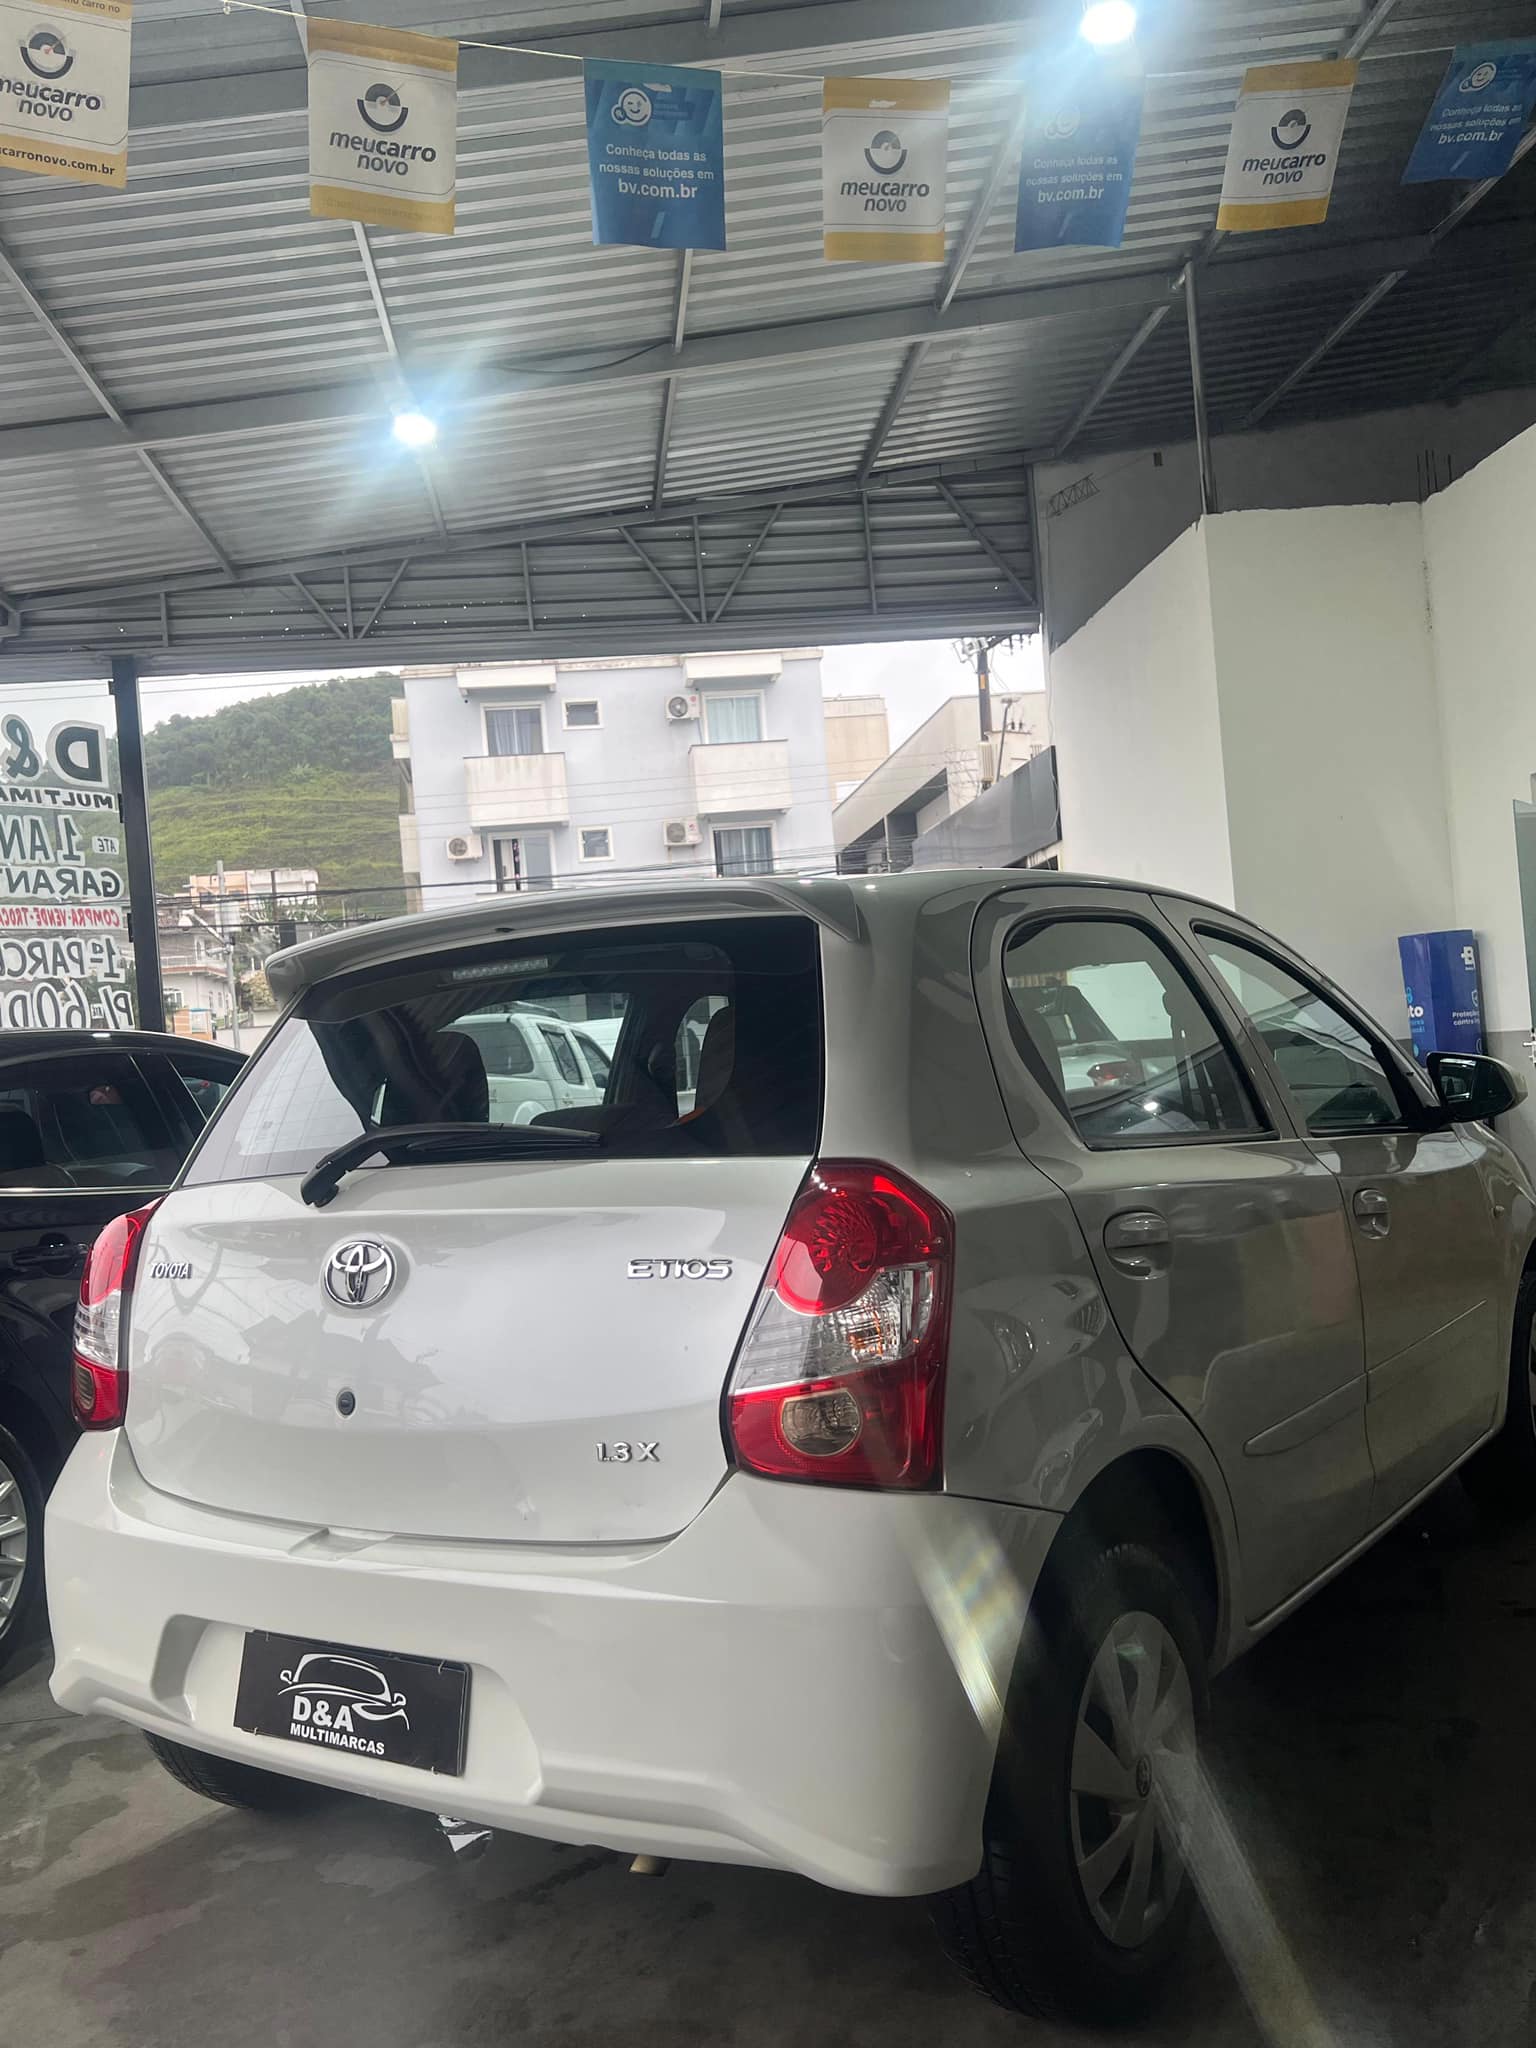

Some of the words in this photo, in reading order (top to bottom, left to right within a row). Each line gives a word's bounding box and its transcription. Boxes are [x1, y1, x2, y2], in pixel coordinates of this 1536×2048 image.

[19, 99, 73, 122] novo
[329, 131, 437, 162] meucarro
[1438, 130, 1505, 145] bv.com.br
[0, 146, 115, 175] carronovo.com.br
[606, 143, 656, 161] Conheça
[658, 148, 690, 161] todas
[693, 152, 707, 162] as
[357, 154, 409, 176] novo
[599, 163, 641, 175] nossas
[643, 167, 695, 181] soluções
[697, 170, 714, 181] em
[1242, 153, 1326, 172] meucarro
[1262, 170, 1304, 185] novo
[618, 178, 698, 199] bv.com.br
[840, 181, 930, 197] meucarro
[1037, 185, 1105, 203] bv.com.br
[864, 198, 907, 212] novo
[149, 1262, 192, 1279] TOYOTA
[627, 1259, 733, 1279] ETIOS
[292, 1695, 354, 1732] D&A
[290, 1722, 385, 1755] MULTIMARCAS
